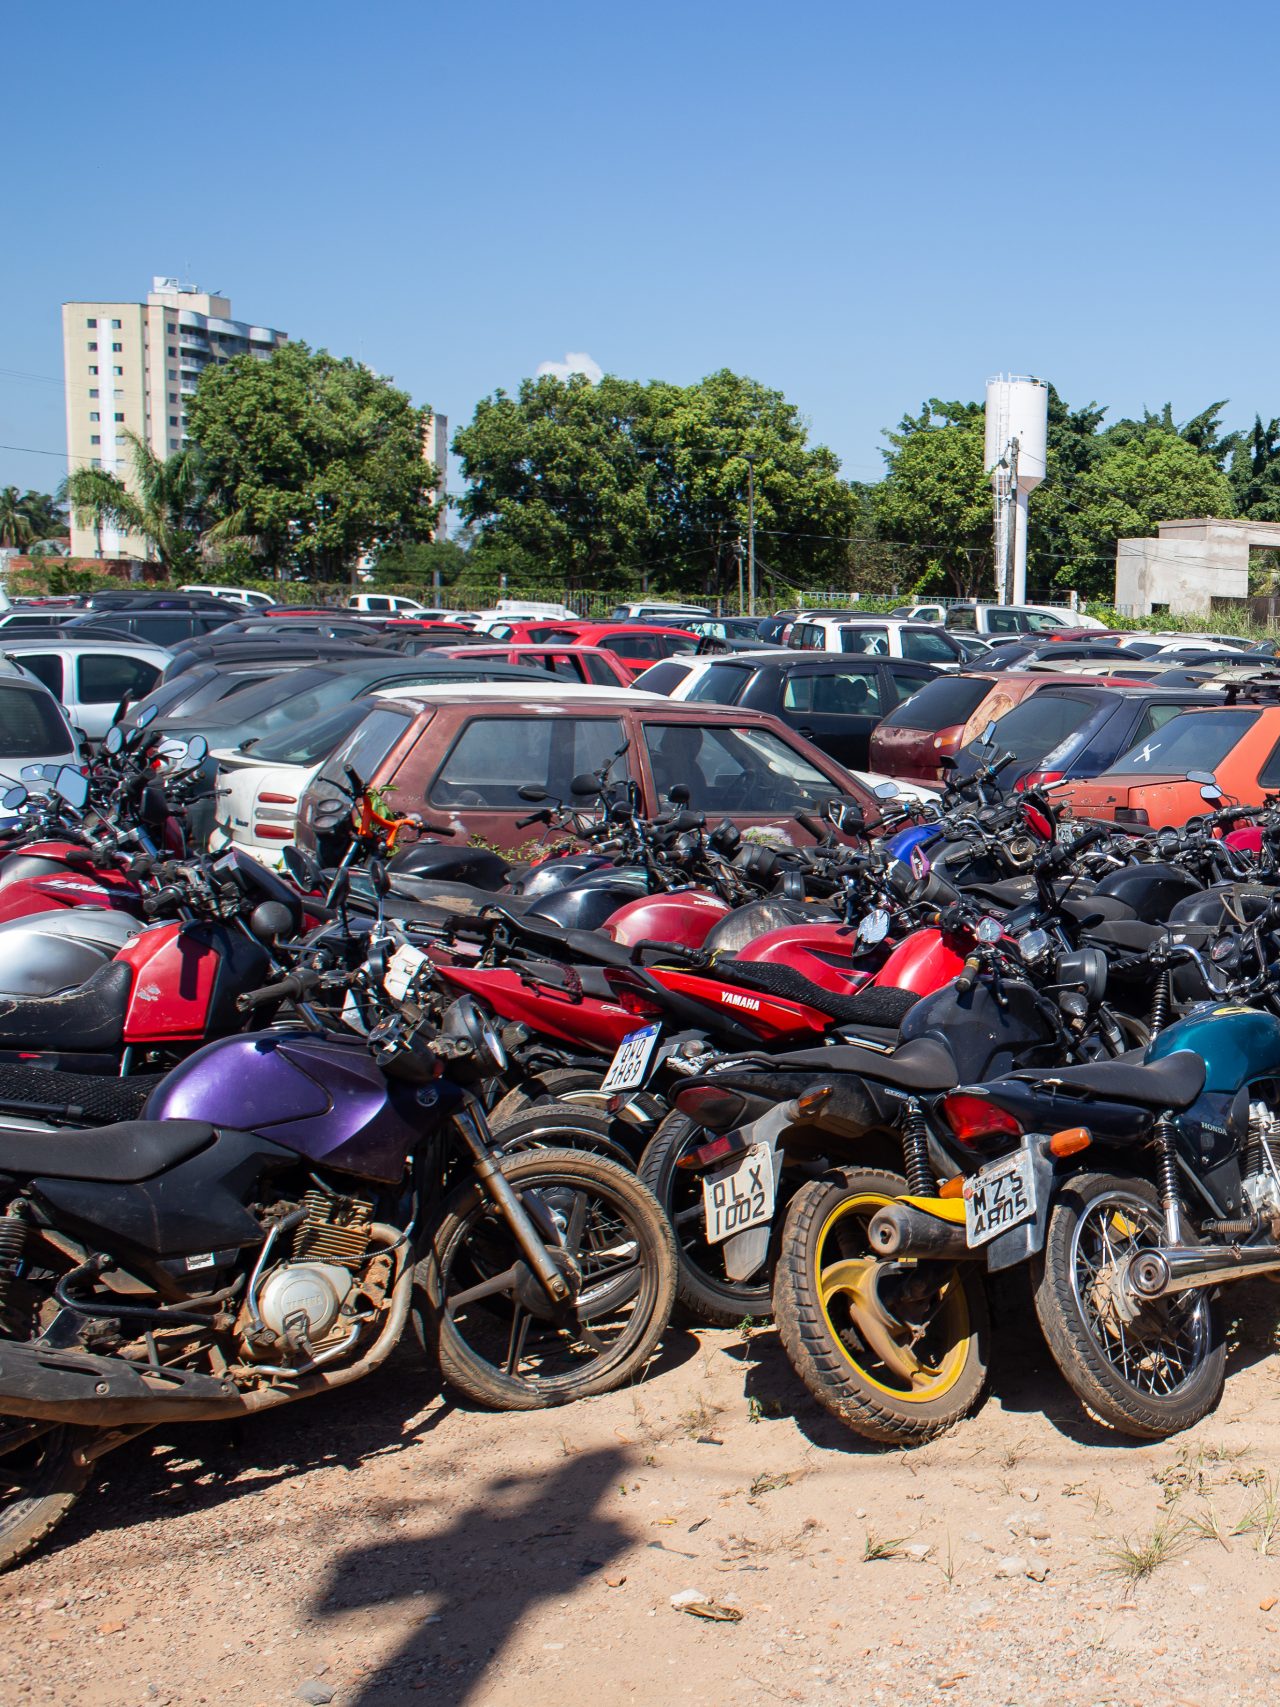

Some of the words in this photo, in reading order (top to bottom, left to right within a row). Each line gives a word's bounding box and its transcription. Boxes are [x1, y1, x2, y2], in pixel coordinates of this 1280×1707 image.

[721, 991, 760, 1011] YAMAHA
[1200, 1121, 1228, 1136] HONDA
[713, 1163, 763, 1209] QLX
[973, 1169, 1025, 1217] MZS
[715, 1191, 766, 1236] 1002
